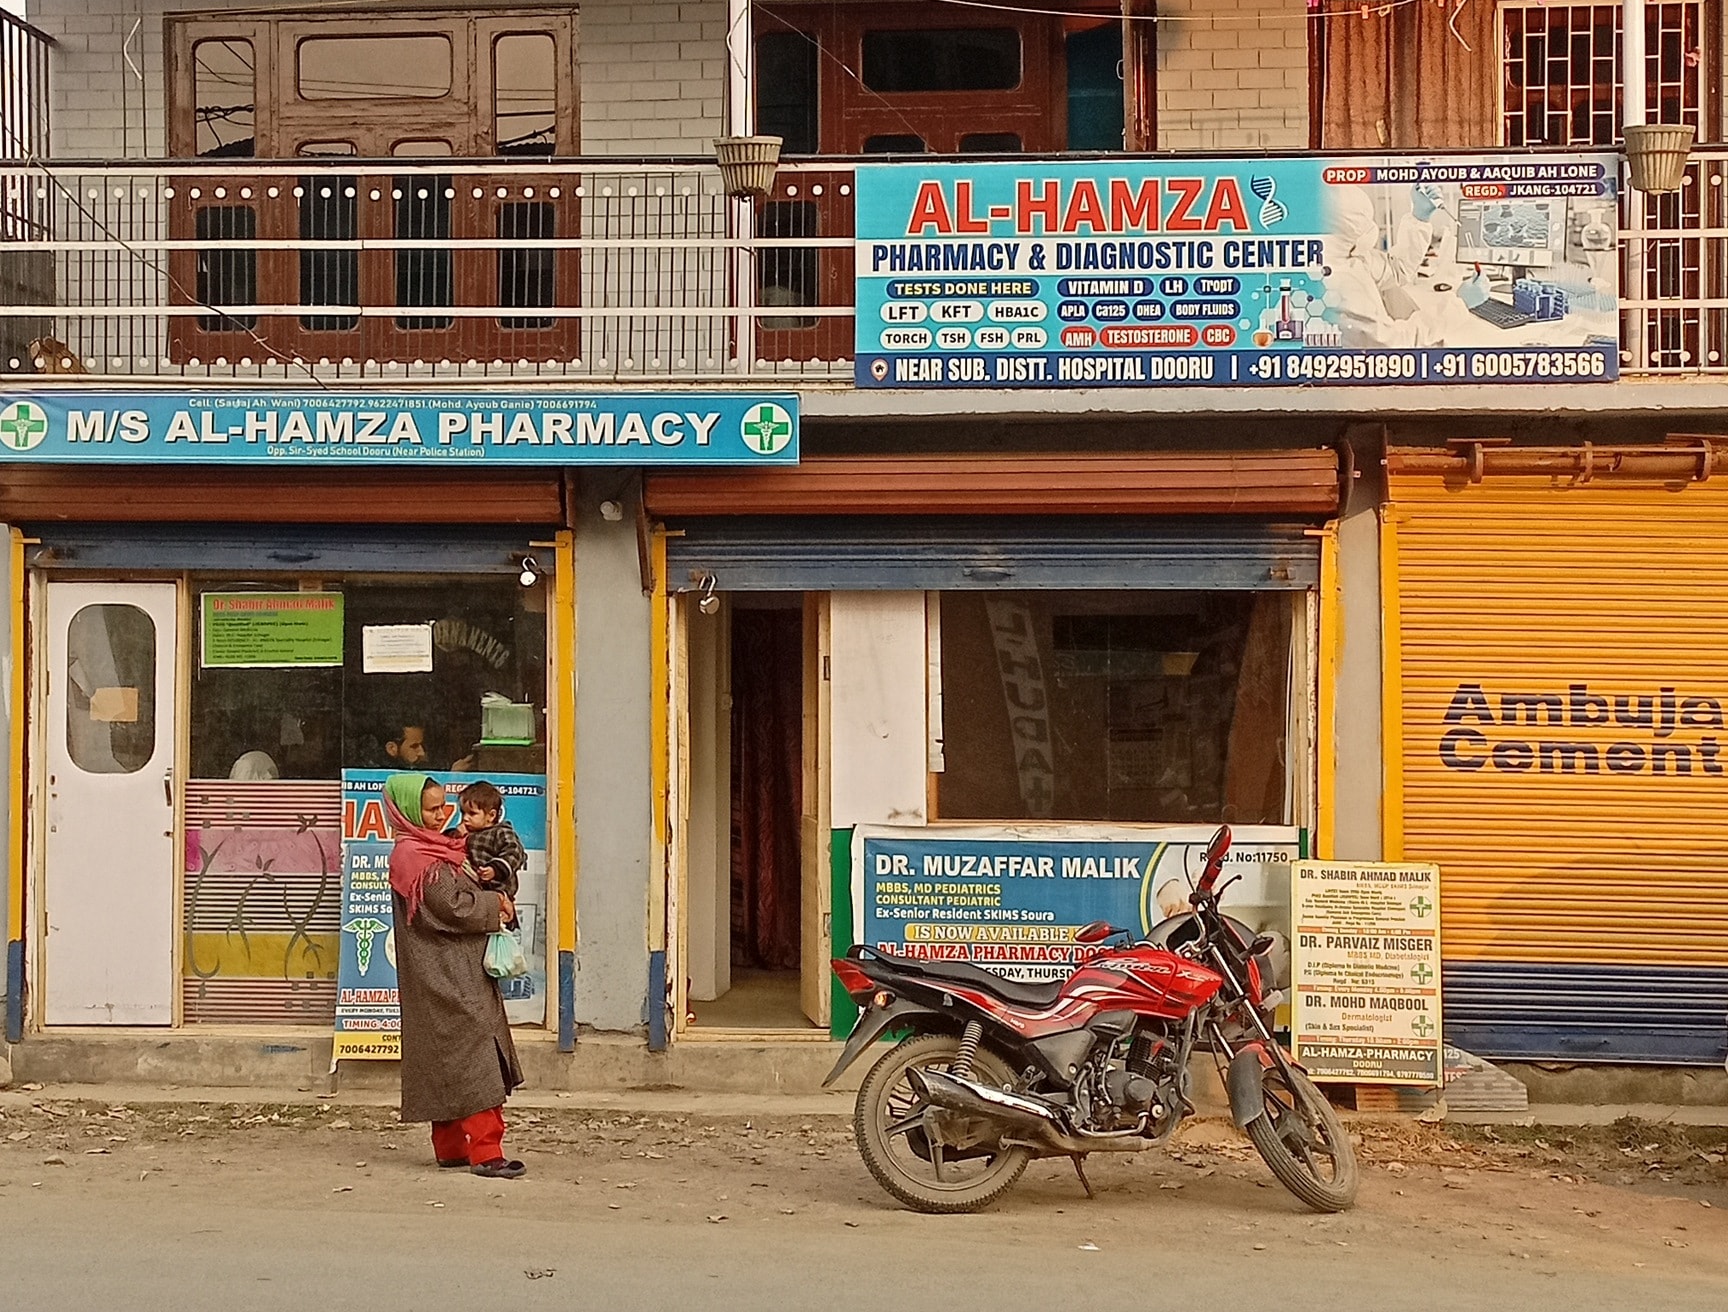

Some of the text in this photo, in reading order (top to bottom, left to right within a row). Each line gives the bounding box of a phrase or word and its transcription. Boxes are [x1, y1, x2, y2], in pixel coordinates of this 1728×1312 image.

[1326, 165, 1598, 182] PROP MOHD AYOUB & AAQUIB AH LONE
[1510, 183, 1598, 196] JKANG-104721
[906, 176, 1250, 236] AL-HAMZA
[872, 239, 1324, 272] PHARMACY & DIAGNOSTIC CENTER
[894, 282, 1032, 296] TESTS DONE HERE
[1068, 280, 1144, 295] VITAMIN D
[1164, 280, 1183, 293] LH
[888, 306, 919, 320] LFT
[942, 305, 972, 319] KFT
[995, 306, 1039, 318] HBA1C
[1061, 305, 1086, 317] APLA
[1136, 305, 1162, 317] DHEA
[1176, 303, 1234, 316] BODY FLUIDS
[885, 333, 927, 344] TORCH
[942, 333, 966, 344] TSH
[980, 332, 1004, 343] FSH
[1017, 332, 1041, 343] PRL
[1065, 332, 1093, 347] AMH
[1107, 329, 1191, 344] TESTOSTERONE
[1206, 329, 1230, 343] CBC
[895, 352, 1605, 381] NEAR SUB. DISTT. HOSPITAL DOORU +91 8492951890 +91 6005783566
[466, 400, 498, 410] Ayoub
[537, 400, 597, 410] 7006691794
[66, 410, 721, 446] M/S AL-HAMZA PHARMACY
[267, 447, 485, 458] Opp. Sir-Syed School Dooru (Near Police Station)
[1442, 684, 1724, 738] Ambuja
[1439, 727, 1724, 777] Cement
[352, 855, 370, 869] DR.
[1200, 852, 1233, 863] Rd.
[876, 855, 1140, 879] DR. MUZAFFAR MALIK
[1300, 869, 1431, 883] DR. SHABIR AHMAD MALIK
[350, 881, 392, 890] CONSULT
[876, 882, 1001, 894] MBBS, MD PEDIATRICS
[349, 891, 392, 902] Ex-Senio
[876, 894, 1001, 906] CONSULTANT PEDIATRIC
[348, 904, 393, 914] SKIMS So
[876, 908, 1055, 921] Ex-Senior Resident SKIMS Soura
[914, 925, 931, 939] IS
[935, 926, 973, 940] NOW
[976, 927, 1069, 941] AVAILABLE
[1300, 935, 1433, 951] DR. PARVAIZ MISGER
[973, 944, 1070, 962] PHARMACY
[986, 968, 1073, 979] SDAY, THURSD
[341, 990, 389, 1003] AL-HAMZA
[1306, 995, 1429, 1011] DR. MOHD MAQBOOL
[340, 1044, 399, 1054] 7006427792
